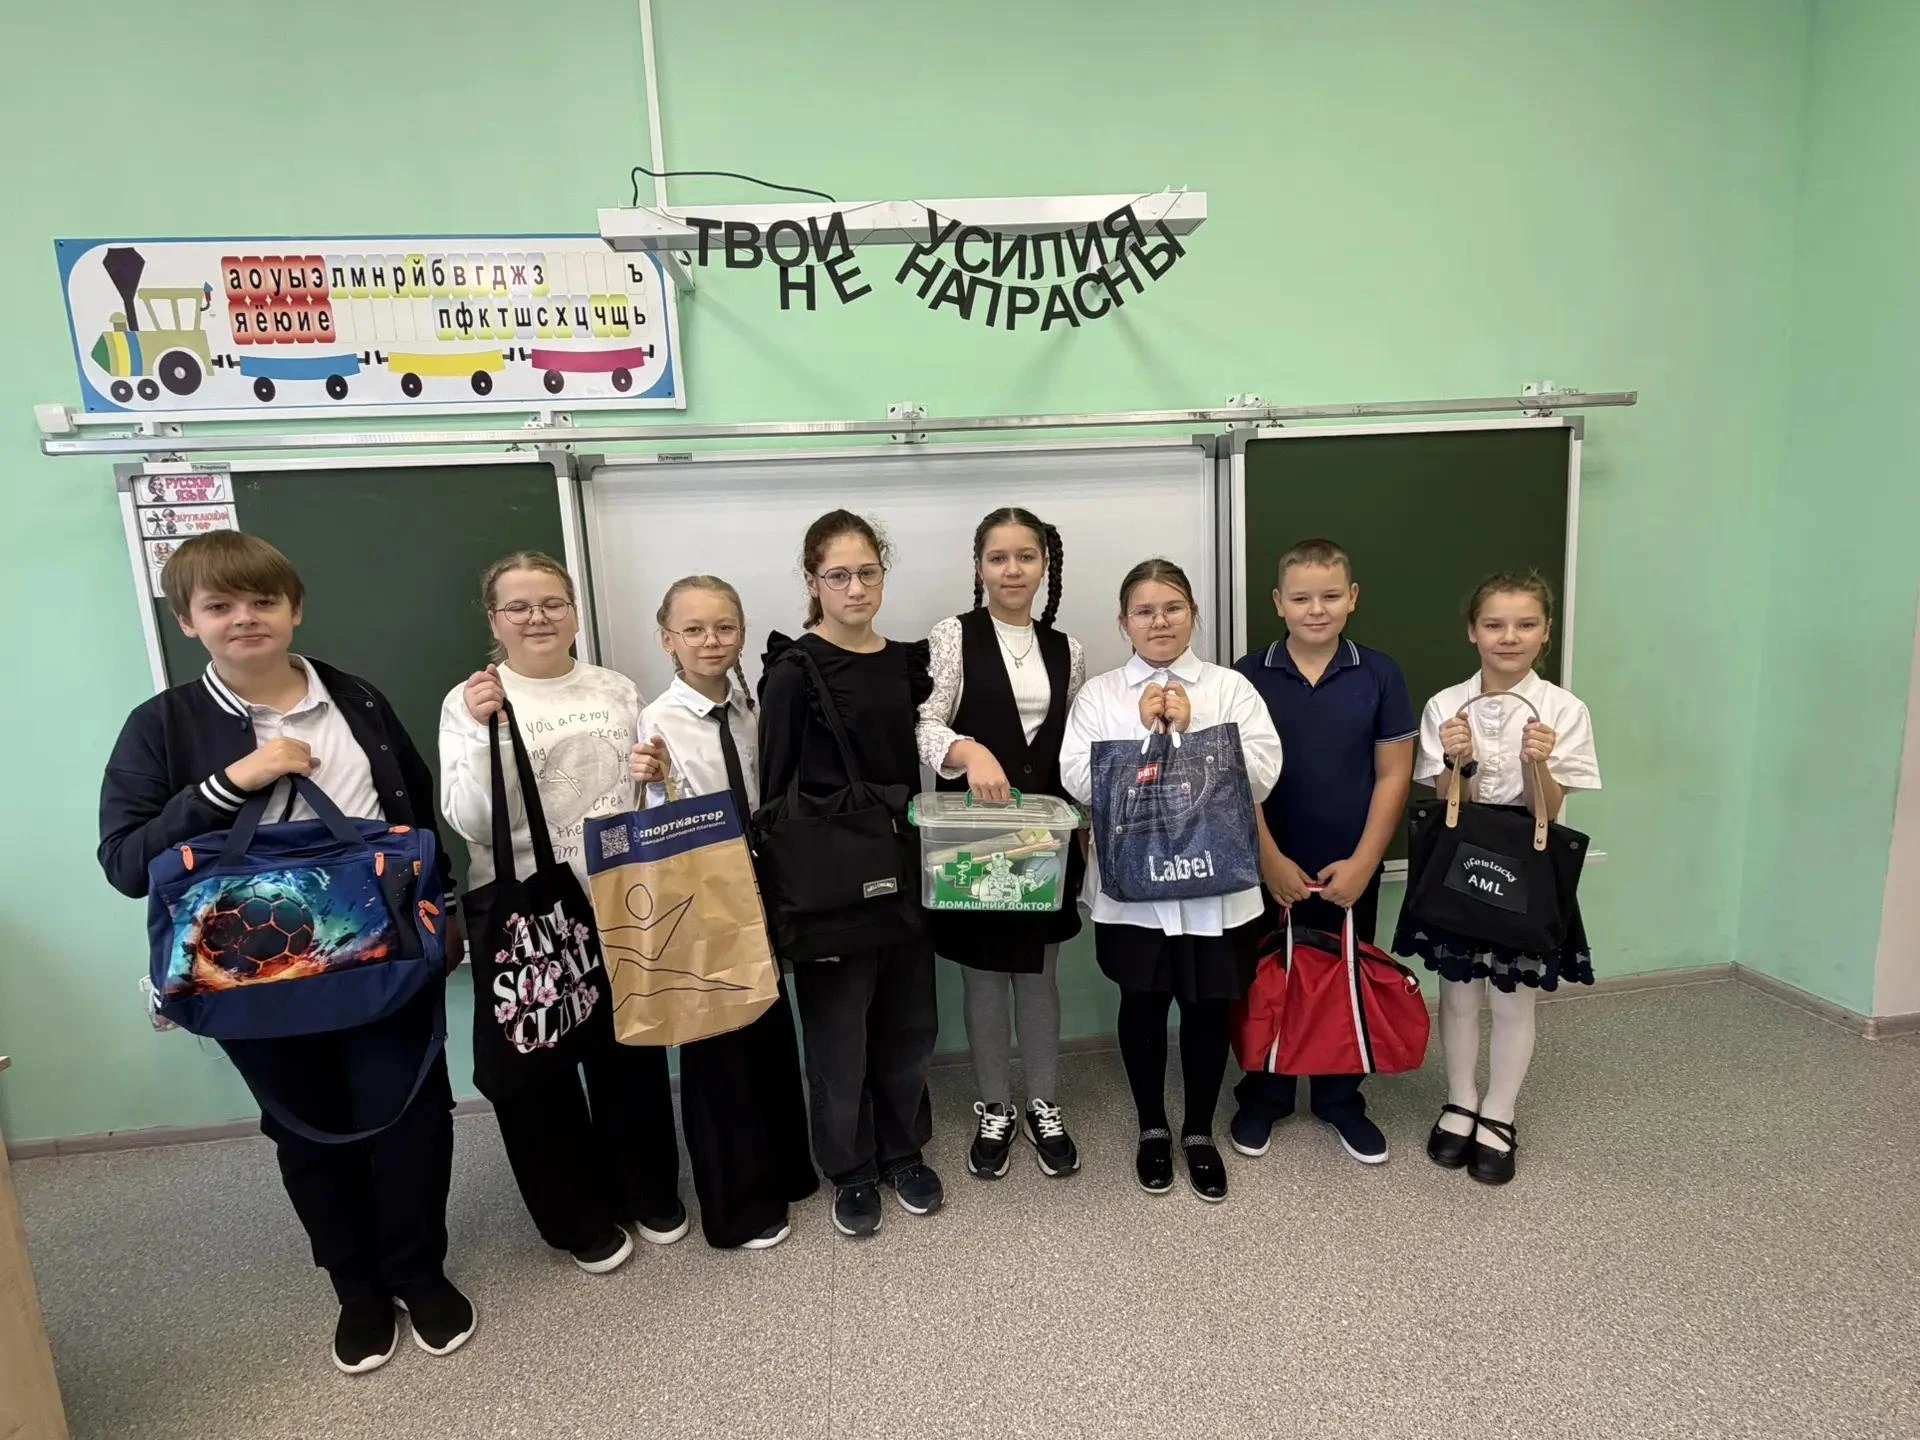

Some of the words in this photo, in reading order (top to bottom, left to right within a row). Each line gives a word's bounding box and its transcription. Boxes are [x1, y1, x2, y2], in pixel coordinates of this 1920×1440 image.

[686, 211, 854, 269] ТВОИ
[923, 204, 1149, 281] УСИЛИЯ
[780, 250, 872, 311] НЕ
[895, 219, 1187, 331] НАПРАСНЫ
[1148, 850, 1215, 882] Label
[1468, 874, 1504, 896] AML
[937, 900, 1005, 910] ДОМАШНИЙ
[1007, 901, 1052, 911] ДОКТОР
